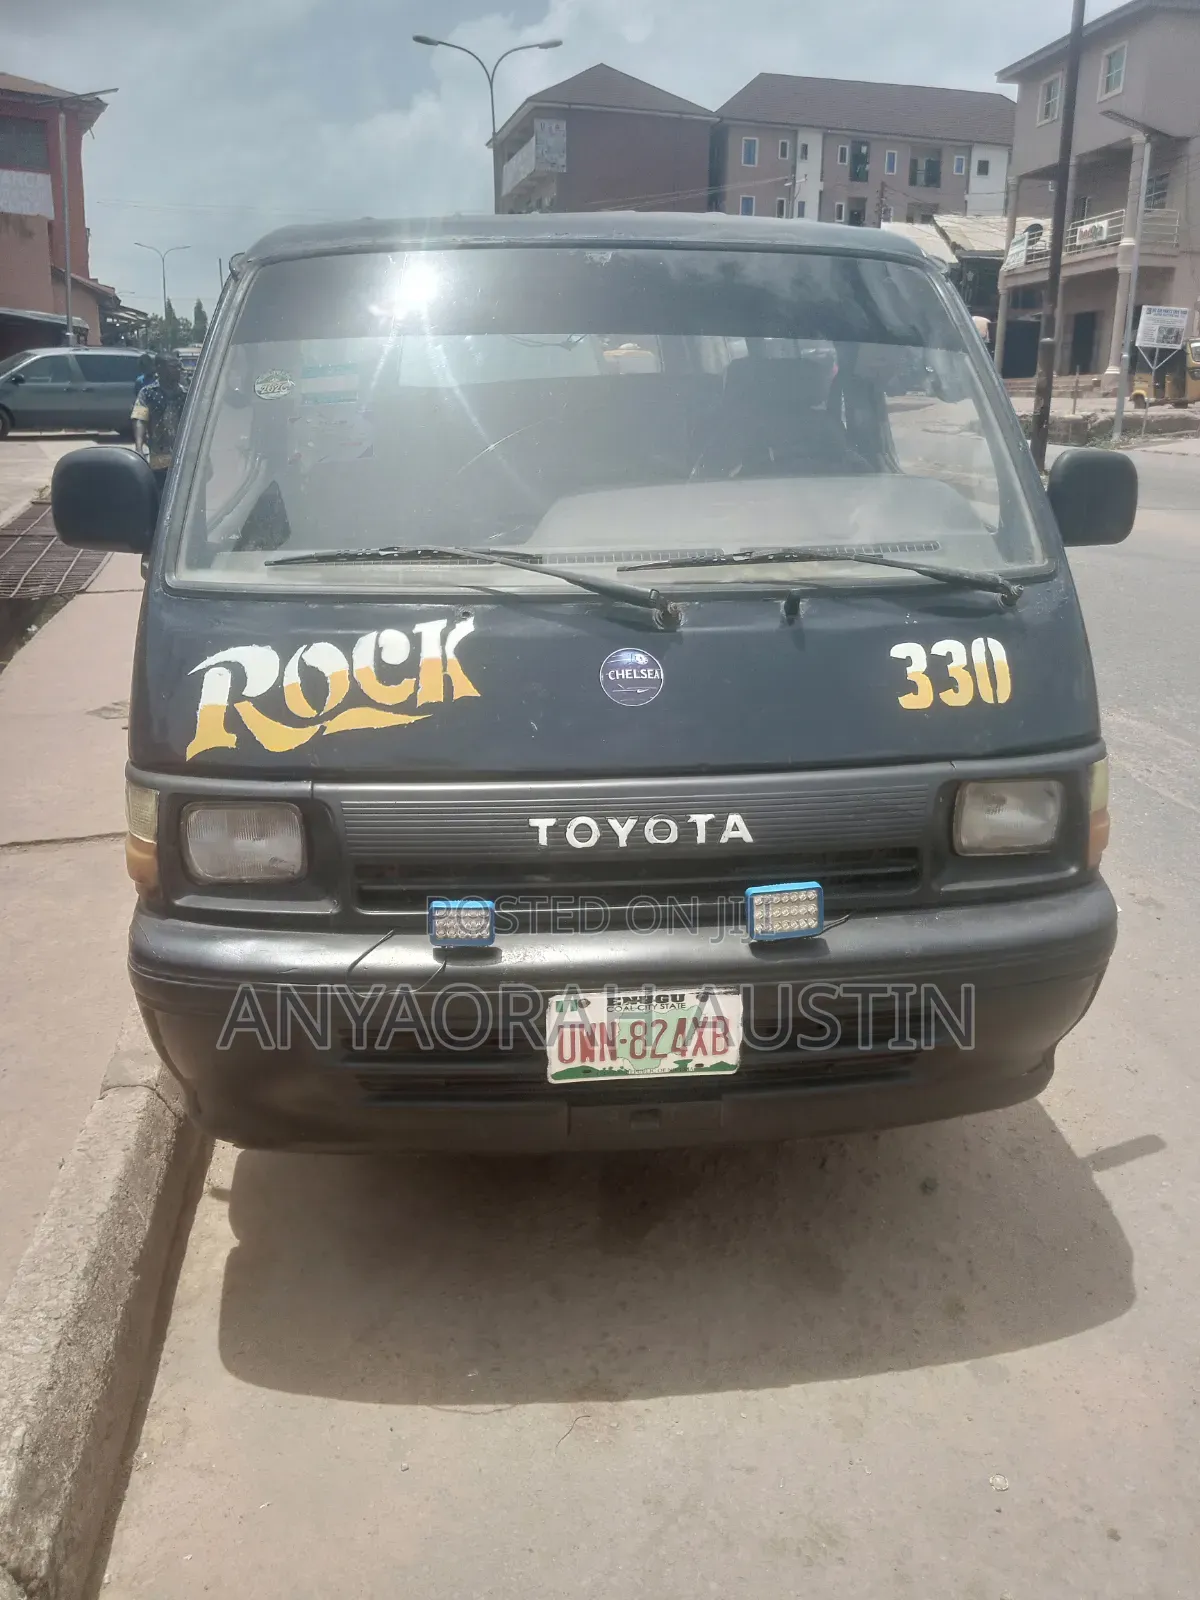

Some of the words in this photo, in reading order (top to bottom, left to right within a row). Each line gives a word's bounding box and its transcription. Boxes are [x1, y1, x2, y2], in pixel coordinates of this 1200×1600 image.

[186, 617, 481, 761] ROCK
[608, 669, 660, 680] CHELSEA
[890, 637, 1011, 709] 330
[528, 813, 754, 849] TOYOTA
[607, 994, 686, 1006] ENUGU
